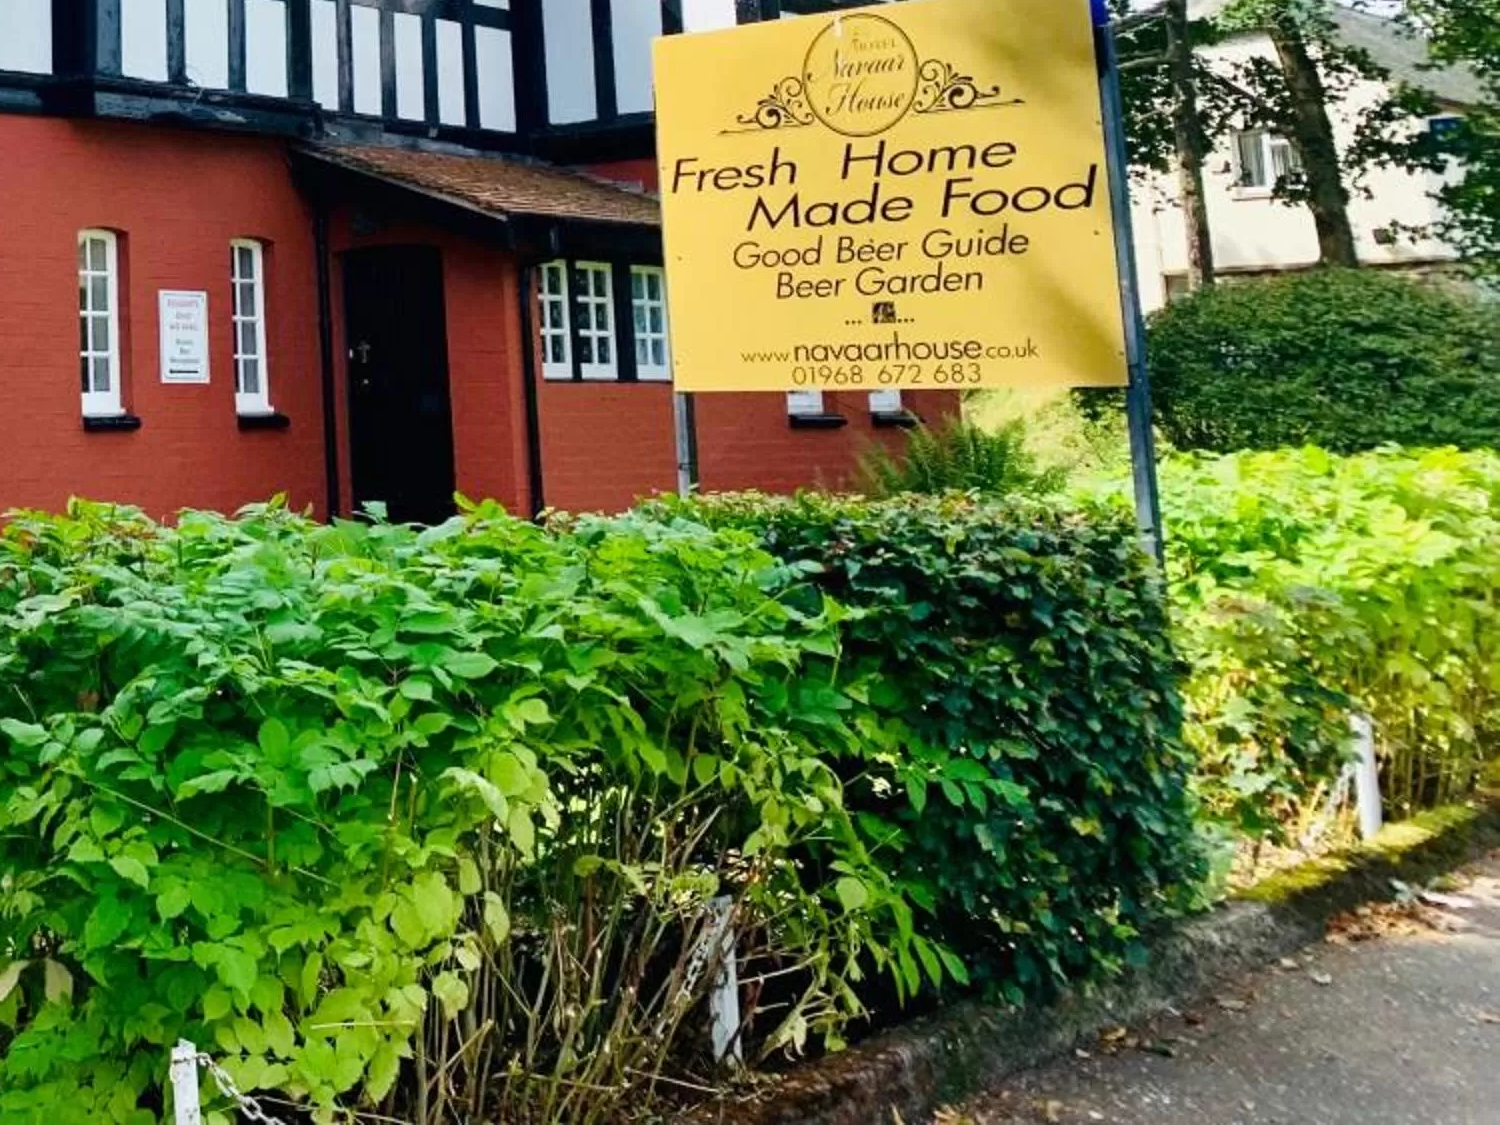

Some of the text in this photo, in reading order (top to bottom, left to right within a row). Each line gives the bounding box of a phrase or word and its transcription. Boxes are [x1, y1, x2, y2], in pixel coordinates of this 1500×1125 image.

[808, 47, 905, 81] Navaar
[825, 77, 905, 116] House
[671, 139, 1017, 193] Fresh Home
[746, 163, 1098, 232] Made Food
[733, 222, 1030, 269] Good Beer Guide
[776, 261, 983, 299] Beer Garden
[740, 330, 1039, 363] www.navaarhouse.co.uk
[791, 362, 982, 385] 01968 672 683
